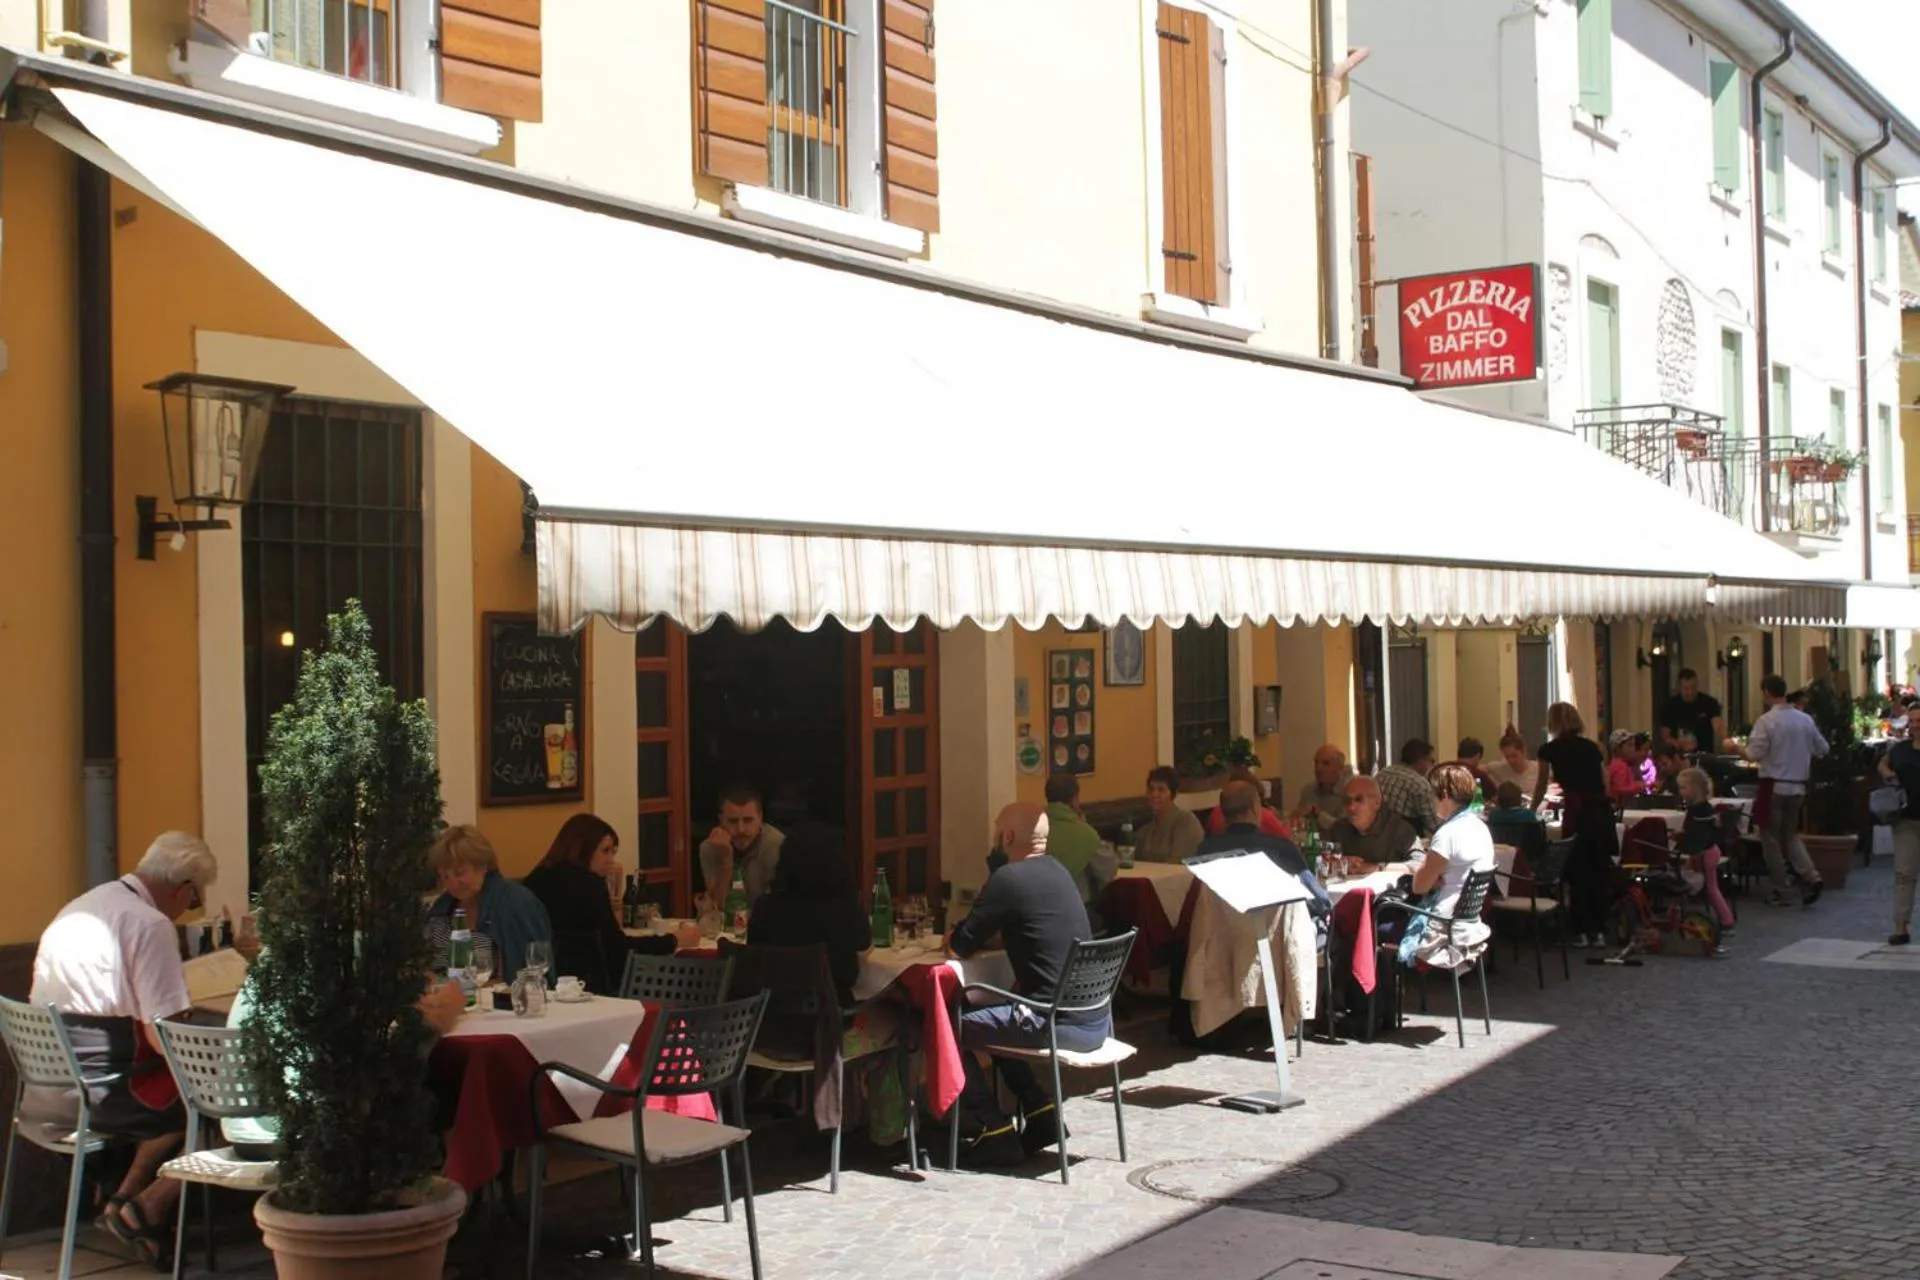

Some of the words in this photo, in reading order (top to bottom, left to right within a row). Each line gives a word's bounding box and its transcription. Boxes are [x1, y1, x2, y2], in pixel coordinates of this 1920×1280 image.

[1403, 279, 1531, 328] PIZZERIA
[1446, 309, 1493, 331] DAL
[1429, 328, 1508, 354] BAFFO
[1420, 355, 1515, 382] ZIMMER
